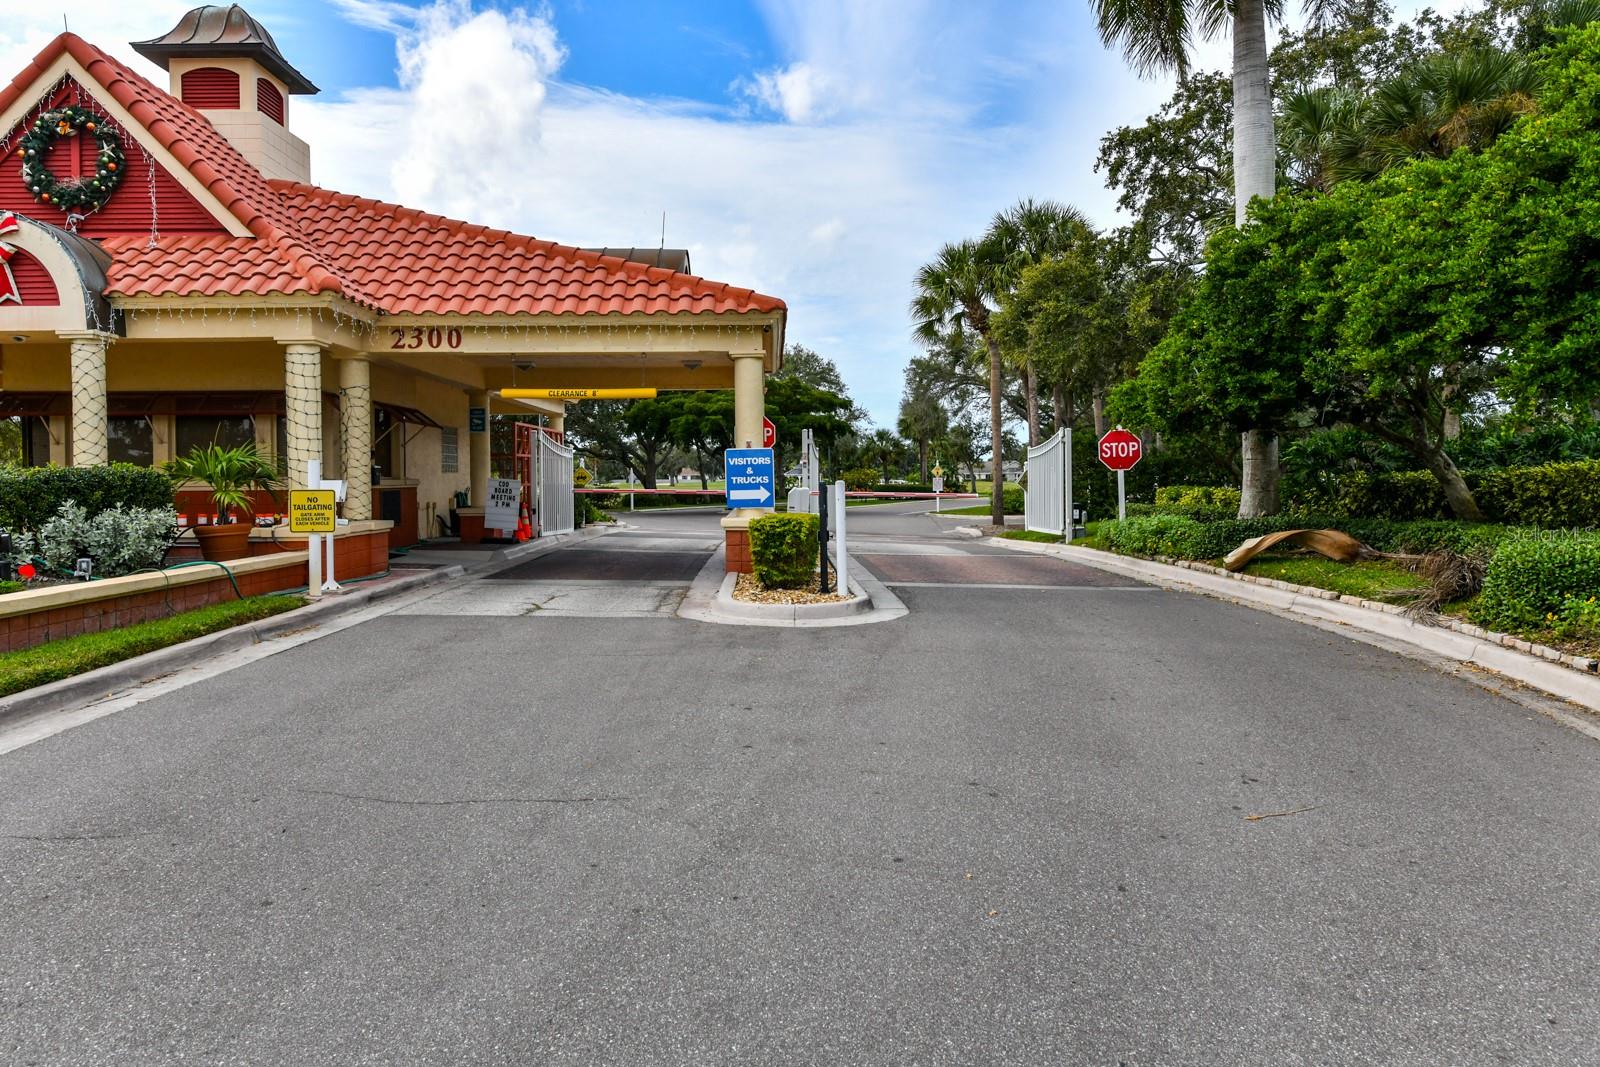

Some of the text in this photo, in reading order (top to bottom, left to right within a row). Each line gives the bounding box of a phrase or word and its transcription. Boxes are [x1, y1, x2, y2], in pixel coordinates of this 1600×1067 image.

[391, 327, 462, 349] 2300
[1101, 441, 1139, 458] STOP
[728, 457, 771, 465] VISITORS
[746, 466, 754, 475] &
[731, 476, 769, 484] TRUCKS
[494, 487, 513, 495] BOARD
[491, 494, 516, 502] MEETING
